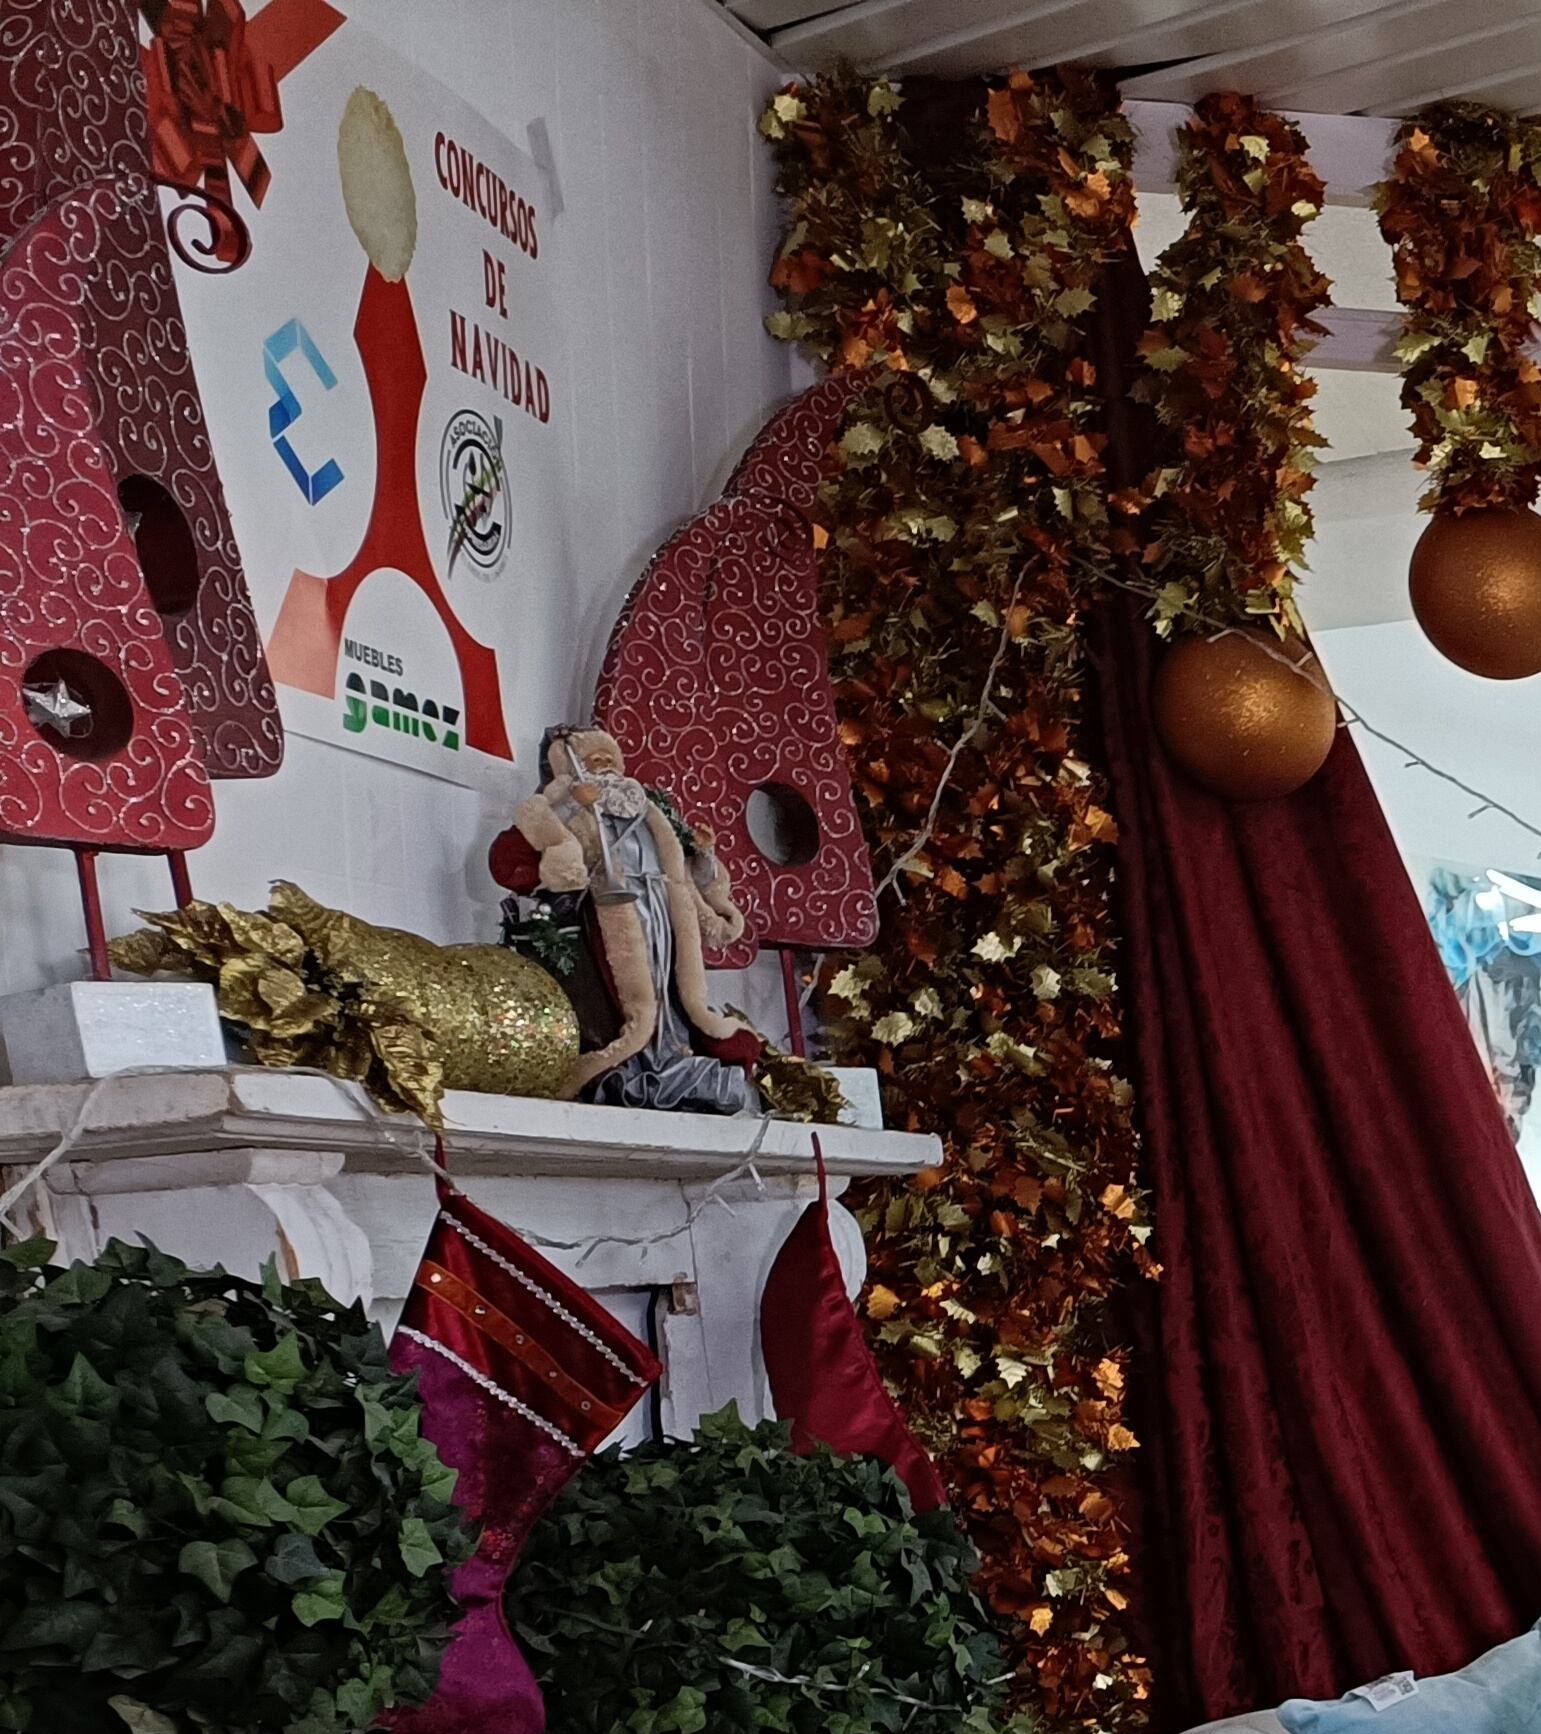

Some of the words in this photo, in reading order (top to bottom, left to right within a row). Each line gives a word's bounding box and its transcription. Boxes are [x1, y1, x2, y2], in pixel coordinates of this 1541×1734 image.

[434, 131, 538, 260] CONCURSOS
[482, 248, 508, 320] DE
[449, 308, 550, 425] NAVIDAD
[344, 637, 404, 677] MUEBLES
[343, 671, 460, 752] gamez
